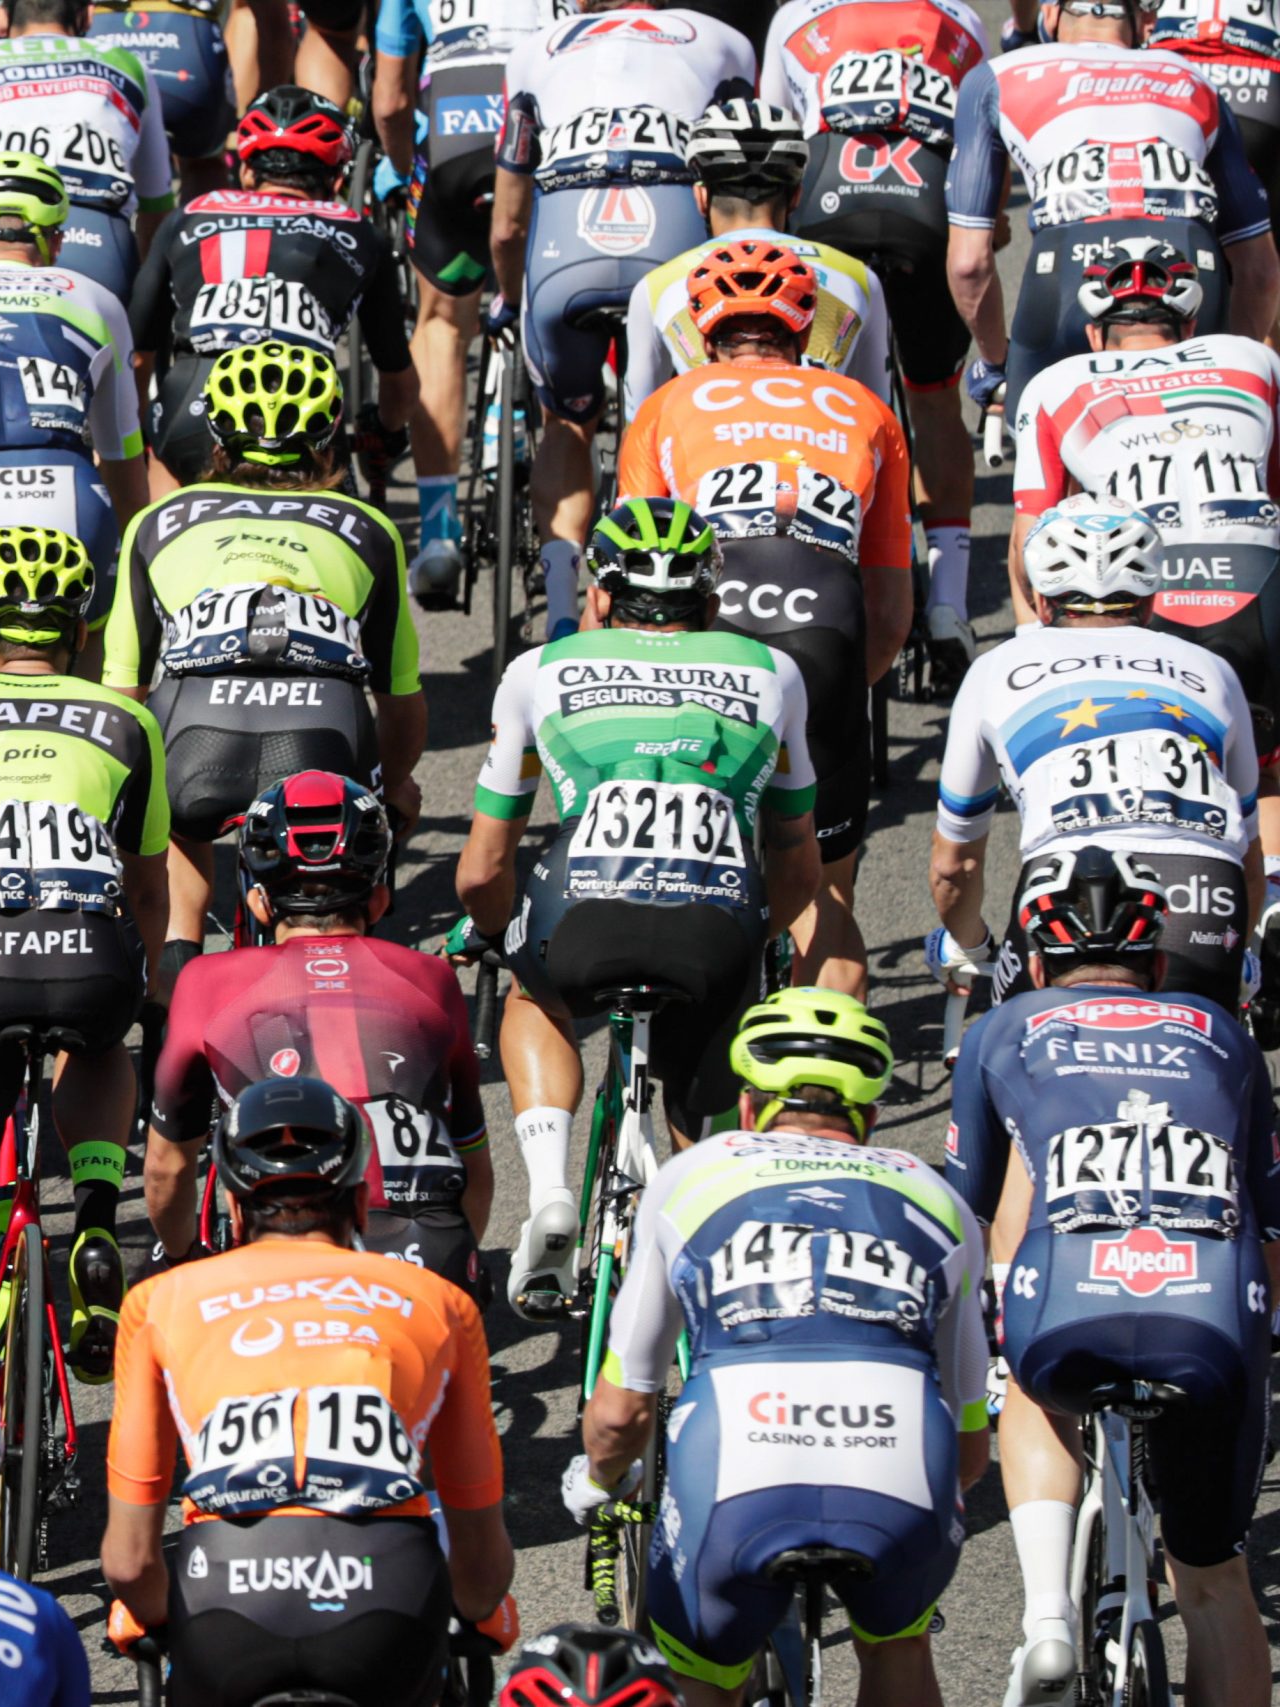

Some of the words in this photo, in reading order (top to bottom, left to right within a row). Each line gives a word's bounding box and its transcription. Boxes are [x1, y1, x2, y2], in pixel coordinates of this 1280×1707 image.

[830, 55, 895, 96] 222
[1057, 72, 1195, 105] Segafredo
[839, 134, 922, 186] OK
[839, 185, 852, 195] OK
[853, 185, 920, 197] EMBALAGENS
[180, 216, 359, 250] LOULETANO
[201, 285, 266, 319] 185
[1089, 345, 1213, 373] UAE
[1092, 371, 1223, 395] Emirates
[693, 378, 857, 426] CCC
[713, 422, 847, 454] sprandi
[4, 490, 12, 499] &
[15, 490, 56, 499] SPORT
[710, 465, 763, 507] 22
[157, 499, 362, 545] EFAPEL
[241, 533, 308, 552] prio
[1162, 558, 1233, 580] UAE
[718, 580, 818, 622] CCC
[1162, 594, 1236, 607] Emirates
[291, 641, 315, 653] GRUPO
[166, 651, 241, 670] Portinsurance
[558, 665, 644, 687] CAJA
[652, 668, 760, 698] RURAL
[1007, 654, 1207, 693] Cofidis
[209, 679, 323, 706] EFAPEL
[568, 688, 674, 711] SEGUROS
[679, 691, 750, 722] RGA
[3, 744, 57, 762] prio
[634, 739, 703, 756] REPENTE
[1070, 739, 1119, 787] 31
[1161, 739, 1210, 796] 31
[584, 785, 655, 849] 132
[570, 869, 598, 877] GRUPO
[657, 871, 687, 879] GRUPO
[657, 879, 741, 897] Portinsurance
[1189, 931, 1224, 945] Nalini
[1054, 1001, 1195, 1023] Alpecin
[1046, 1037, 1189, 1068] FENIX
[1056, 1066, 1124, 1077] INNOVATIVE
[1127, 1066, 1191, 1079] MATERIALS
[771, 1158, 875, 1175] TORMANS
[1050, 1123, 1138, 1188] 127
[1150, 1205, 1181, 1214] GRUPO
[1101, 1245, 1186, 1280] Alpecin
[824, 1288, 855, 1301] GRUPO
[1165, 1282, 1212, 1296] SHAMPOO
[294, 1320, 381, 1341] DBA
[748, 1391, 896, 1429] Circus
[748, 1431, 816, 1447] CASINO
[822, 1433, 835, 1447] &
[843, 1435, 897, 1449] SPORT
[308, 1474, 343, 1487] GRUPO
